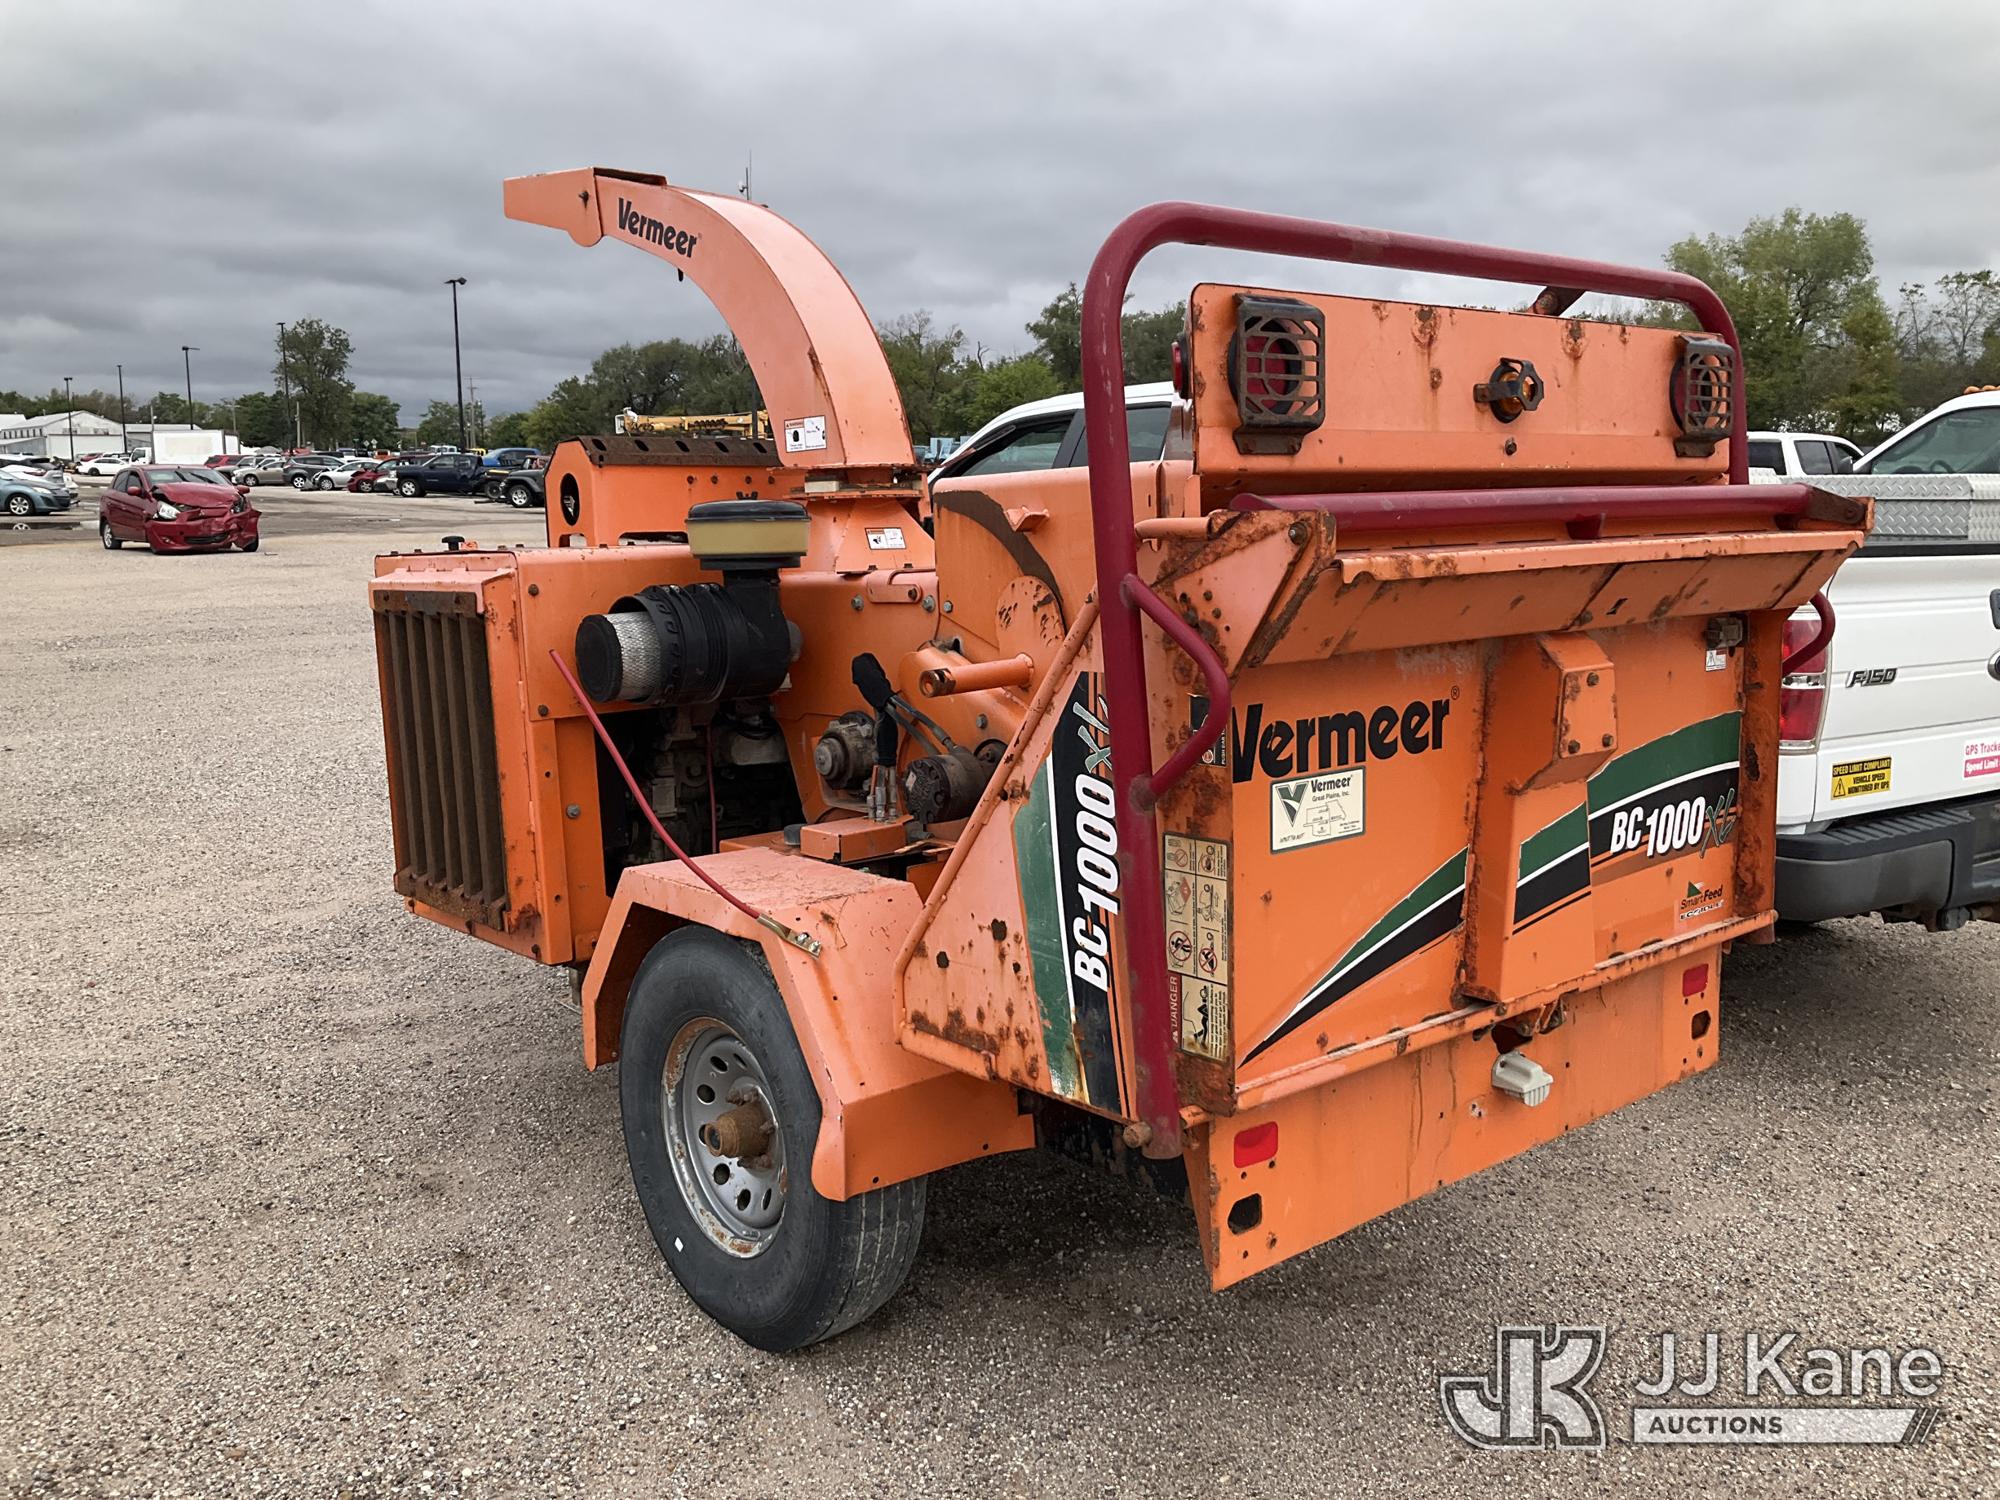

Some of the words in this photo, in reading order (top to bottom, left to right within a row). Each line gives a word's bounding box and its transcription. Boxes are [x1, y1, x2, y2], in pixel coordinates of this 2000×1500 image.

[618, 197, 697, 258] Vermeer
[1845, 667, 1898, 688] F-150
[1232, 699, 1450, 783] Vermeer
[1965, 744, 1978, 755] GPS
[1833, 765, 1848, 775] SPEED
[1311, 776, 1351, 793] Vermeer
